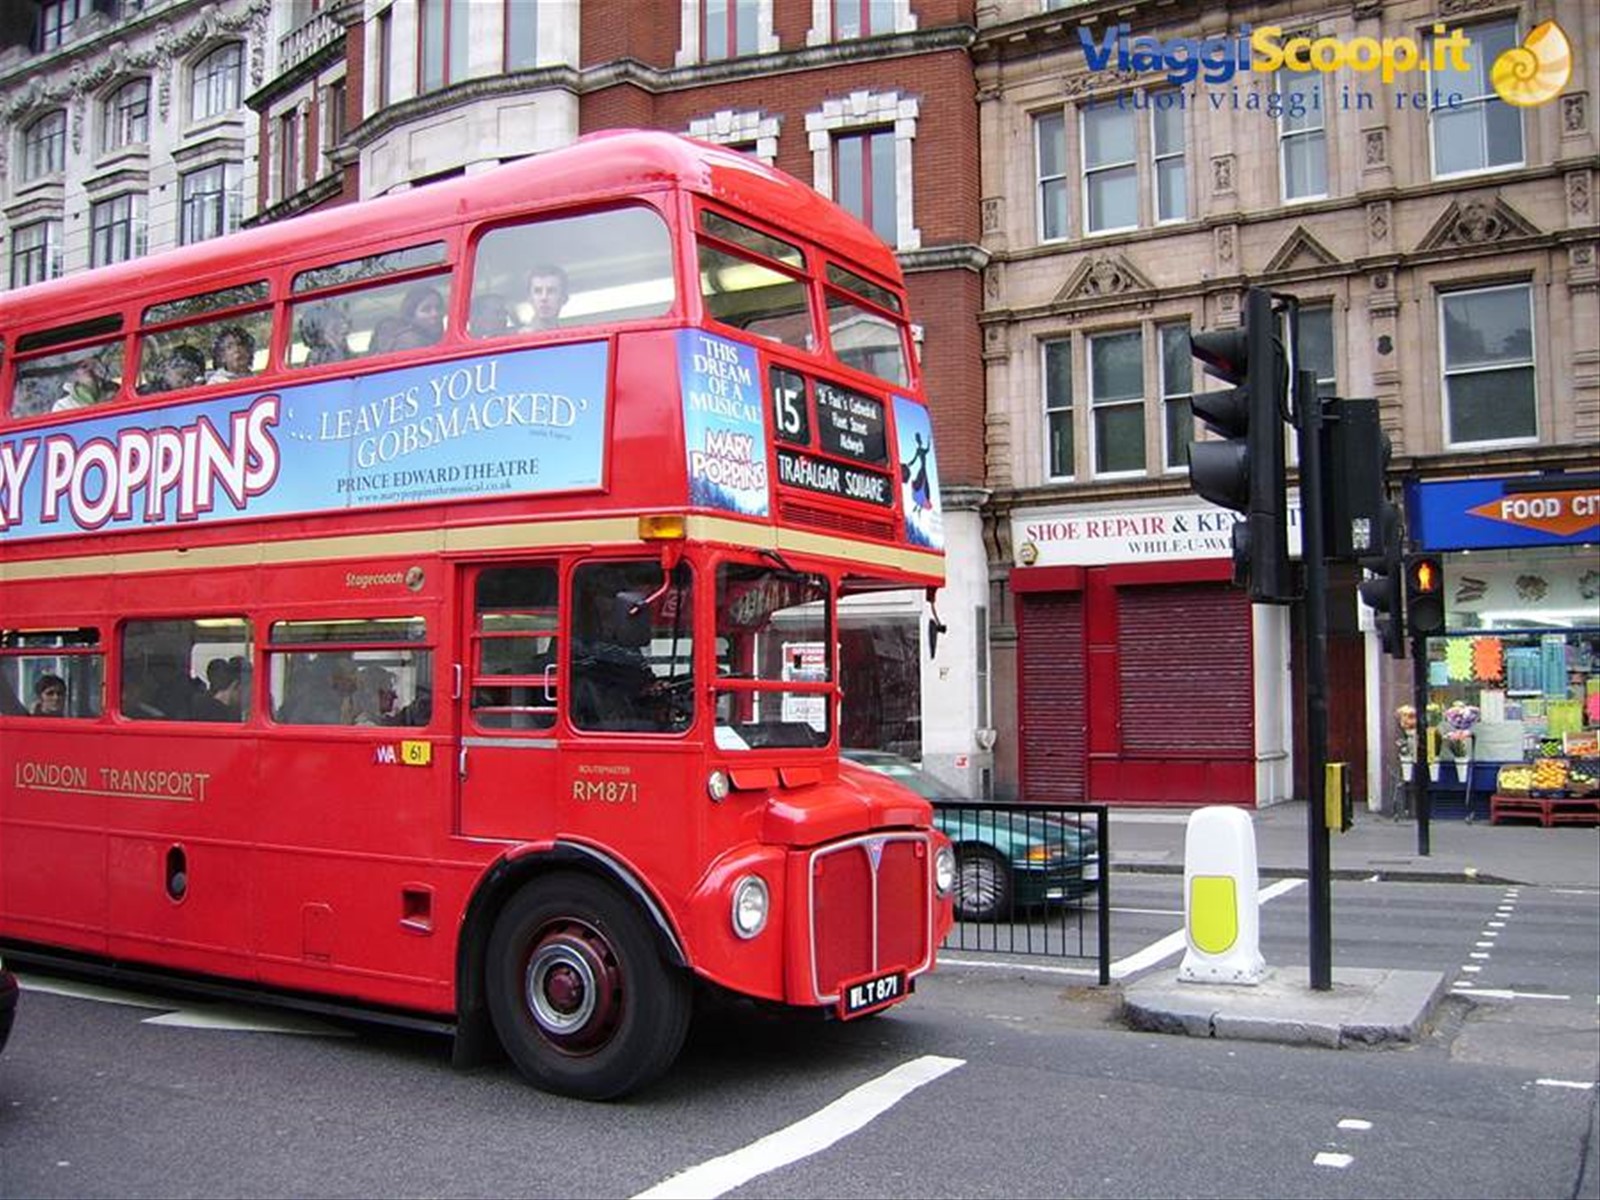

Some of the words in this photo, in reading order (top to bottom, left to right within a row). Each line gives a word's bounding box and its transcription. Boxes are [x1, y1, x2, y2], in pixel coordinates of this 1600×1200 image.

[430, 360, 498, 408] YOU
[693, 354, 752, 386] DREAM
[708, 376, 729, 396] OF
[733, 385, 744, 401] A
[774, 387, 801, 435] 15
[0, 438, 41, 532] Y
[40, 394, 281, 530] POPPINS
[706, 428, 754, 464] MARY
[336, 471, 390, 494] PRINCE
[393, 463, 460, 489] EDWARD
[463, 458, 539, 482] THEATRE
[690, 450, 765, 491] POPPINS
[778, 455, 841, 493] TRAFALGAR
[845, 472, 884, 502] SQUARE
[1501, 498, 1561, 520] FOOD
[1026, 523, 1081, 542] SHOE
[1086, 516, 1165, 540] REPAIR
[1172, 515, 1189, 534] &
[346, 571, 404, 589] Stagecoach
[410, 745, 421, 761] 61
[15, 762, 88, 788] LONDON
[99, 768, 210, 802] TRANSPORT
[572, 780, 638, 803] RM871
[877, 975, 898, 999] 871
